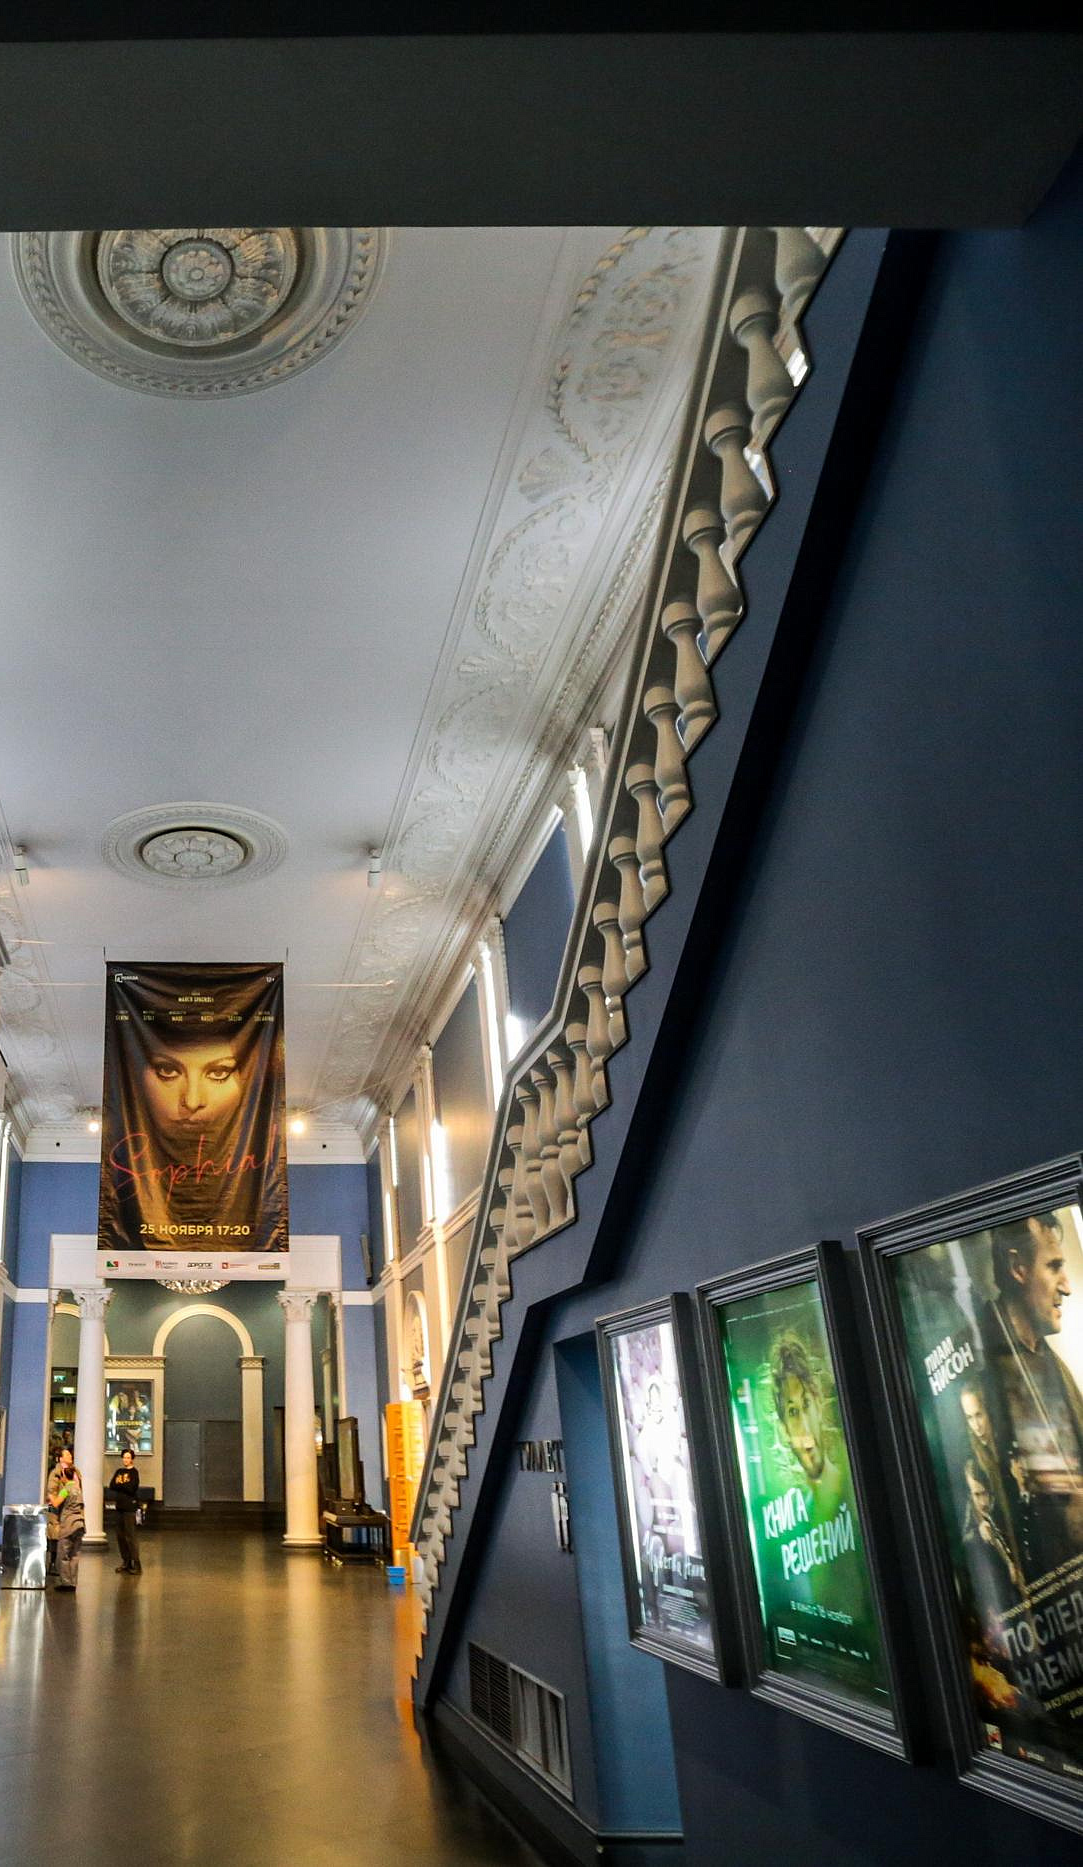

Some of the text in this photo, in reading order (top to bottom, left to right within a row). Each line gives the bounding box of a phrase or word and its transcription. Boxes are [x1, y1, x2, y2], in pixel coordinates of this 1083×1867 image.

[140, 1223, 250, 1236] 25 НОЯБРЯ 17:20
[924, 1335, 955, 1376] ЛИАМ
[929, 1342, 975, 1396] НИСОН
[762, 1488, 809, 1540] КНИГА
[781, 1502, 856, 1580] РЕШЕНИЙ
